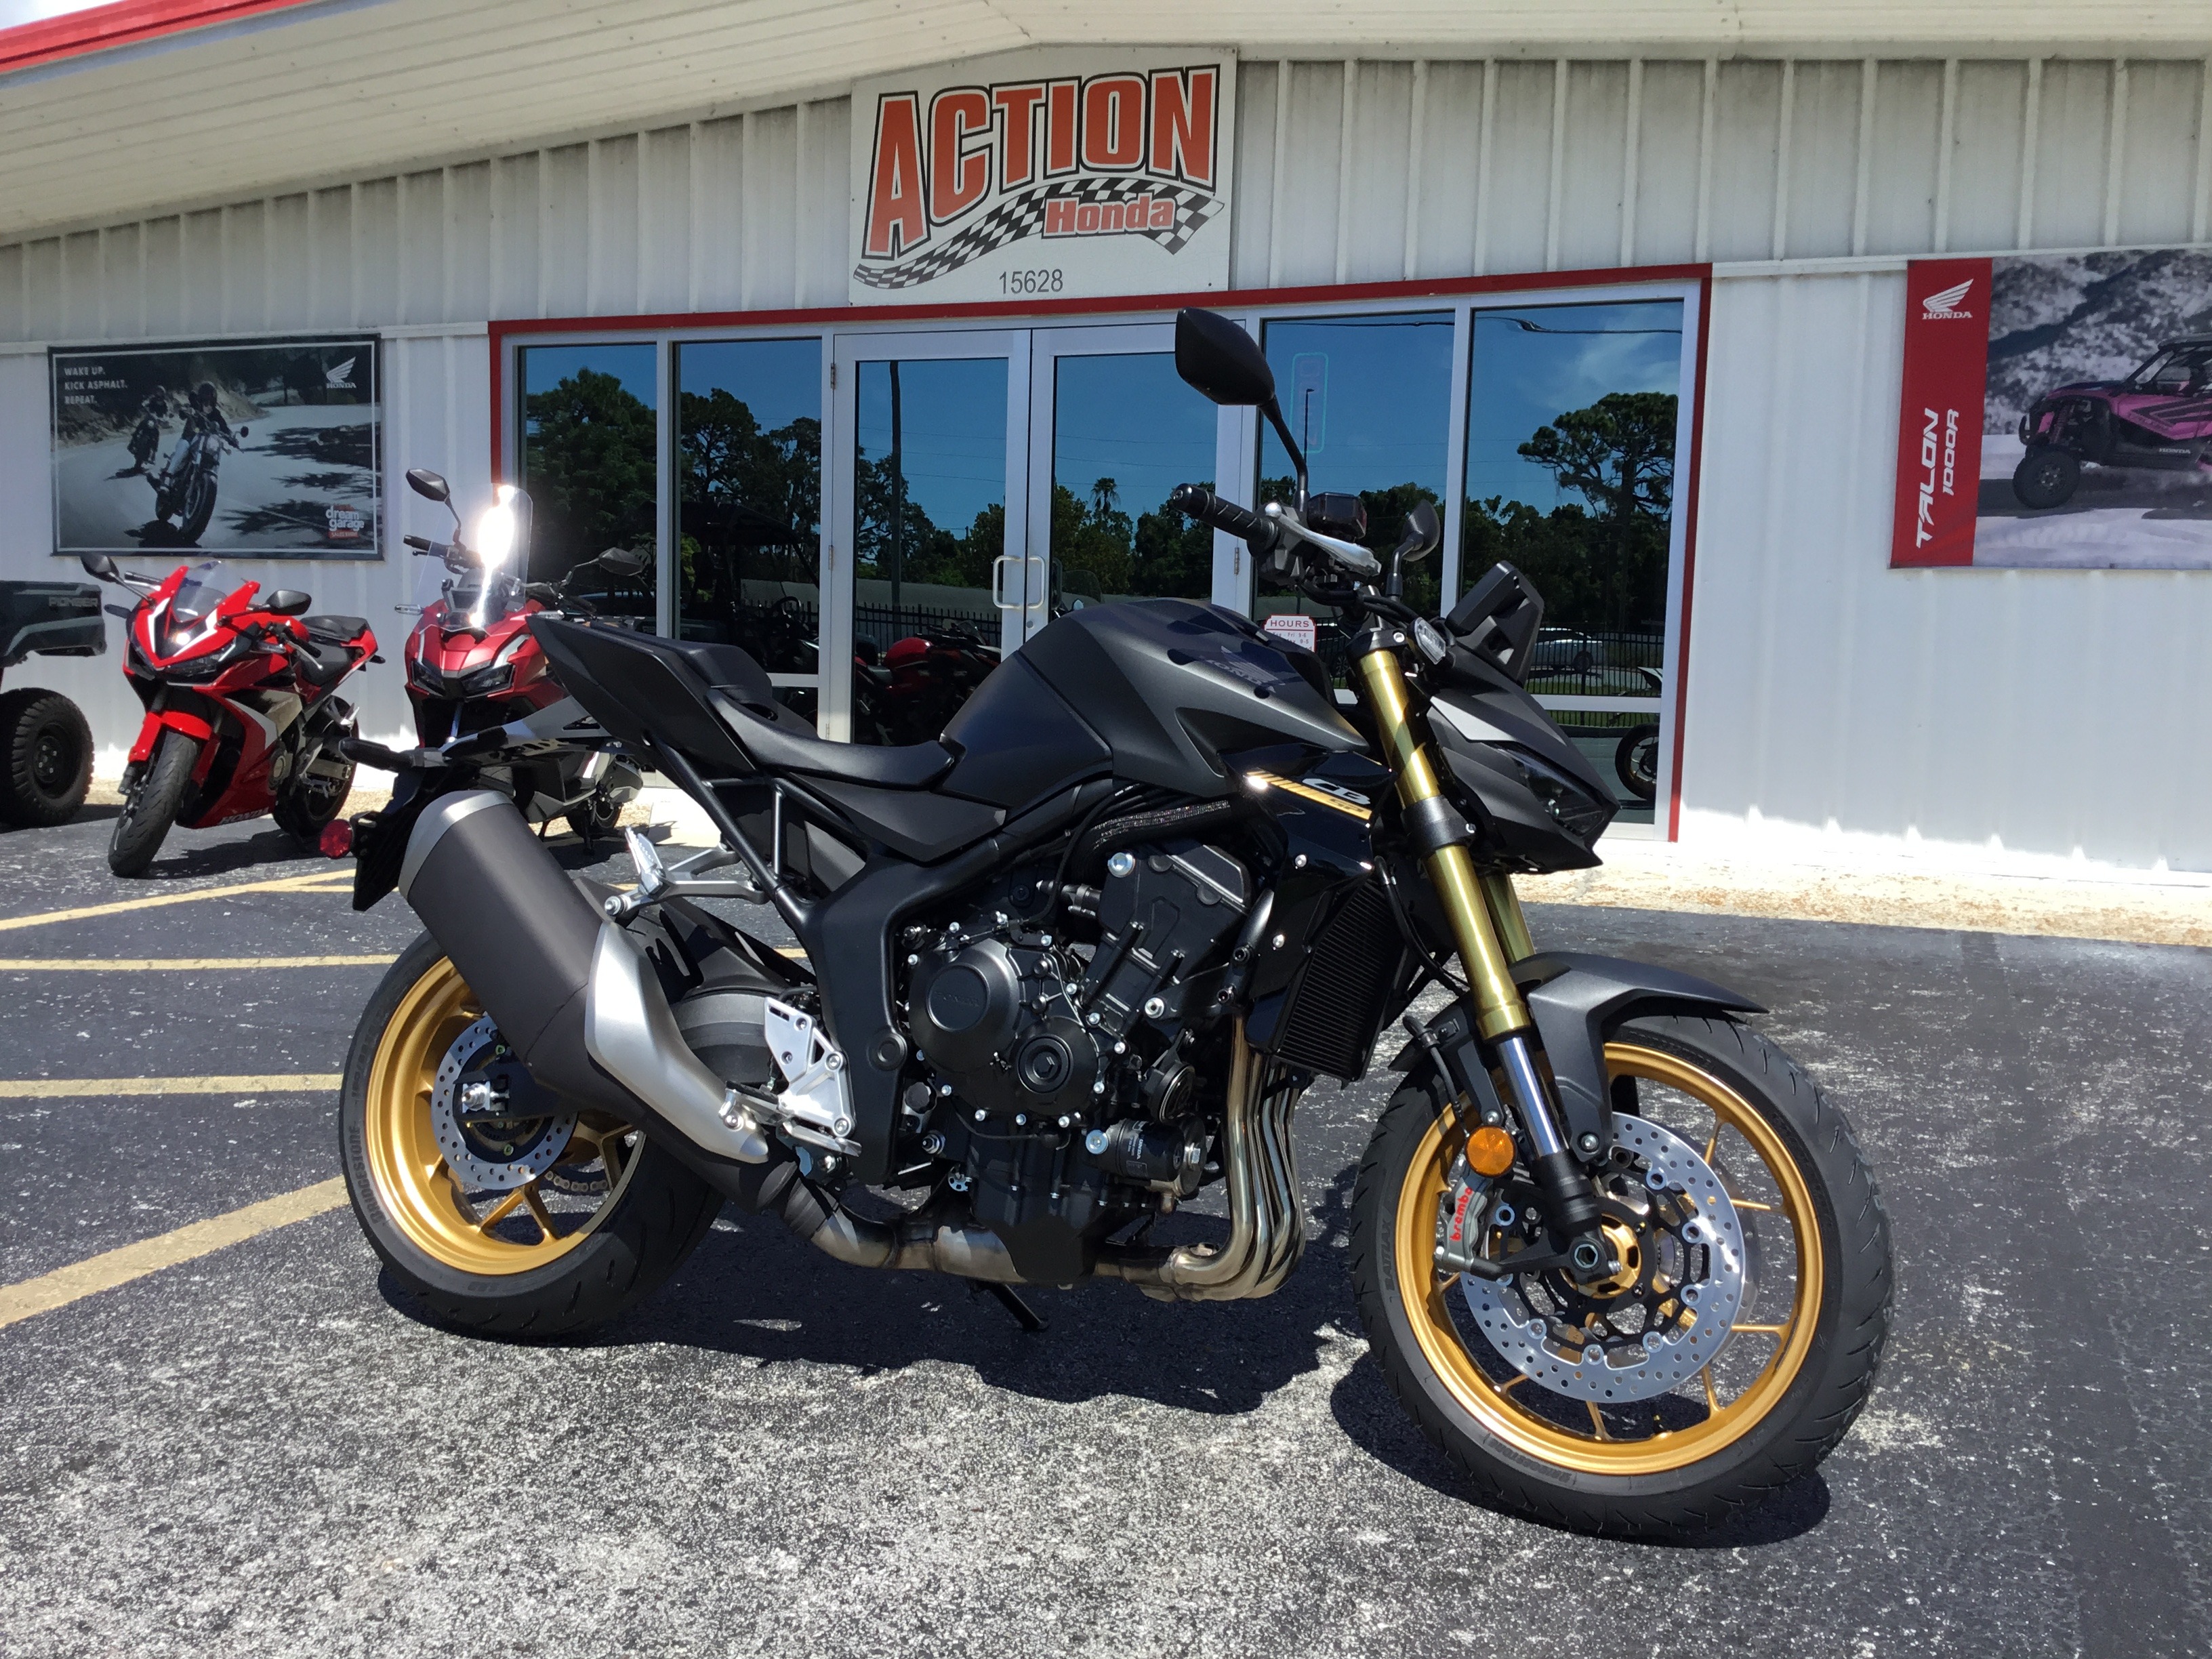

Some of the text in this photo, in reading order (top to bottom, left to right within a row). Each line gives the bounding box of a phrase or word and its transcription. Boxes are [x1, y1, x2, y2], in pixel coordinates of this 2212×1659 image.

[862, 64, 1221, 260] ACTION
[1042, 190, 1178, 239] Honda
[999, 268, 1063, 294] 15628
[1922, 311, 1973, 320] HONDA
[64, 366, 106, 375] WAKE UP.
[64, 379, 127, 390] KICK ASPHALT.
[64, 394, 98, 405] REPEAT.
[1942, 409, 1959, 496] 1000R
[1916, 407, 1938, 548] TALON
[325, 505, 359, 519] dream
[329, 518, 365, 531] garage
[49, 596, 98, 607] PIONEER
[1270, 619, 1309, 628] HOURS
[1302, 778, 1371, 805] CB
[1450, 1187, 1473, 1242] brembo
